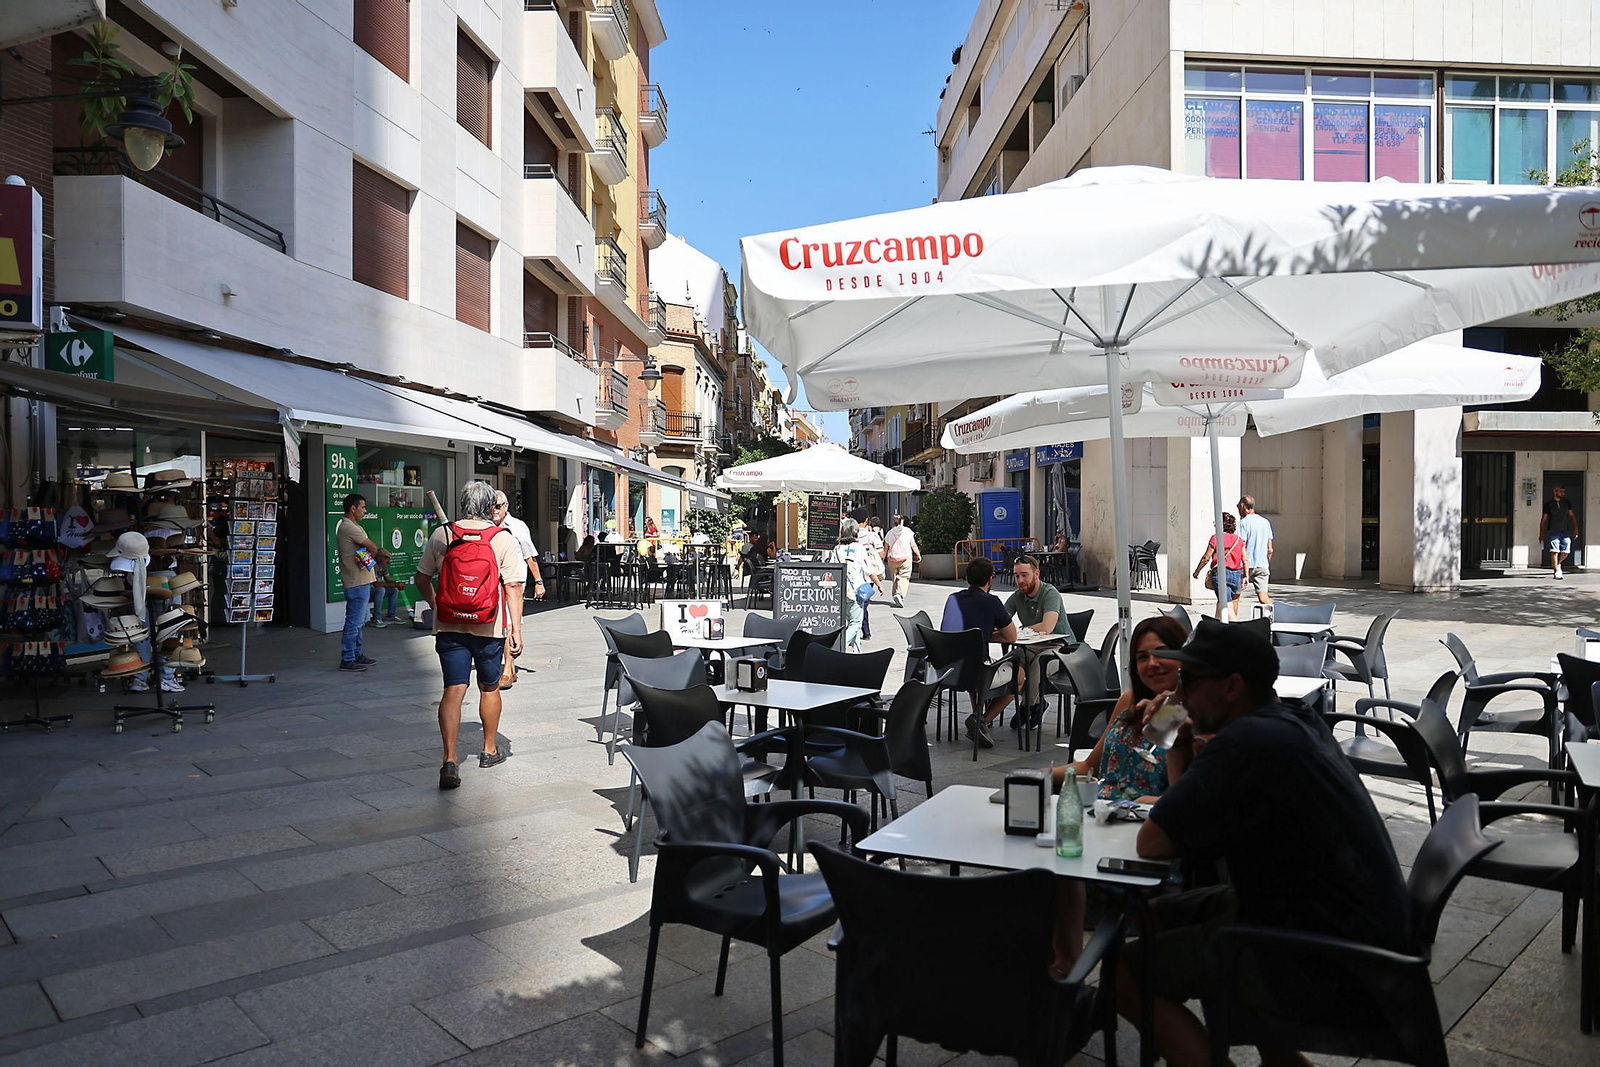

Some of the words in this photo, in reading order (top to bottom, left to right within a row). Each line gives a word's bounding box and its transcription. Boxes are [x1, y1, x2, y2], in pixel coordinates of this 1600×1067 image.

[1256, 116, 1294, 126] GENERAL
[779, 232, 984, 270] Cruzcampo
[826, 274, 882, 291] DESDE
[898, 271, 944, 286] 1904
[1190, 391, 1217, 400] DESDE
[1222, 388, 1244, 398] 1904
[954, 415, 991, 437] Cruzcampo
[331, 453, 346, 470] 9h
[349, 460, 354, 470] a
[331, 472, 353, 489] 22h
[729, 469, 763, 477] Cruzcampo
